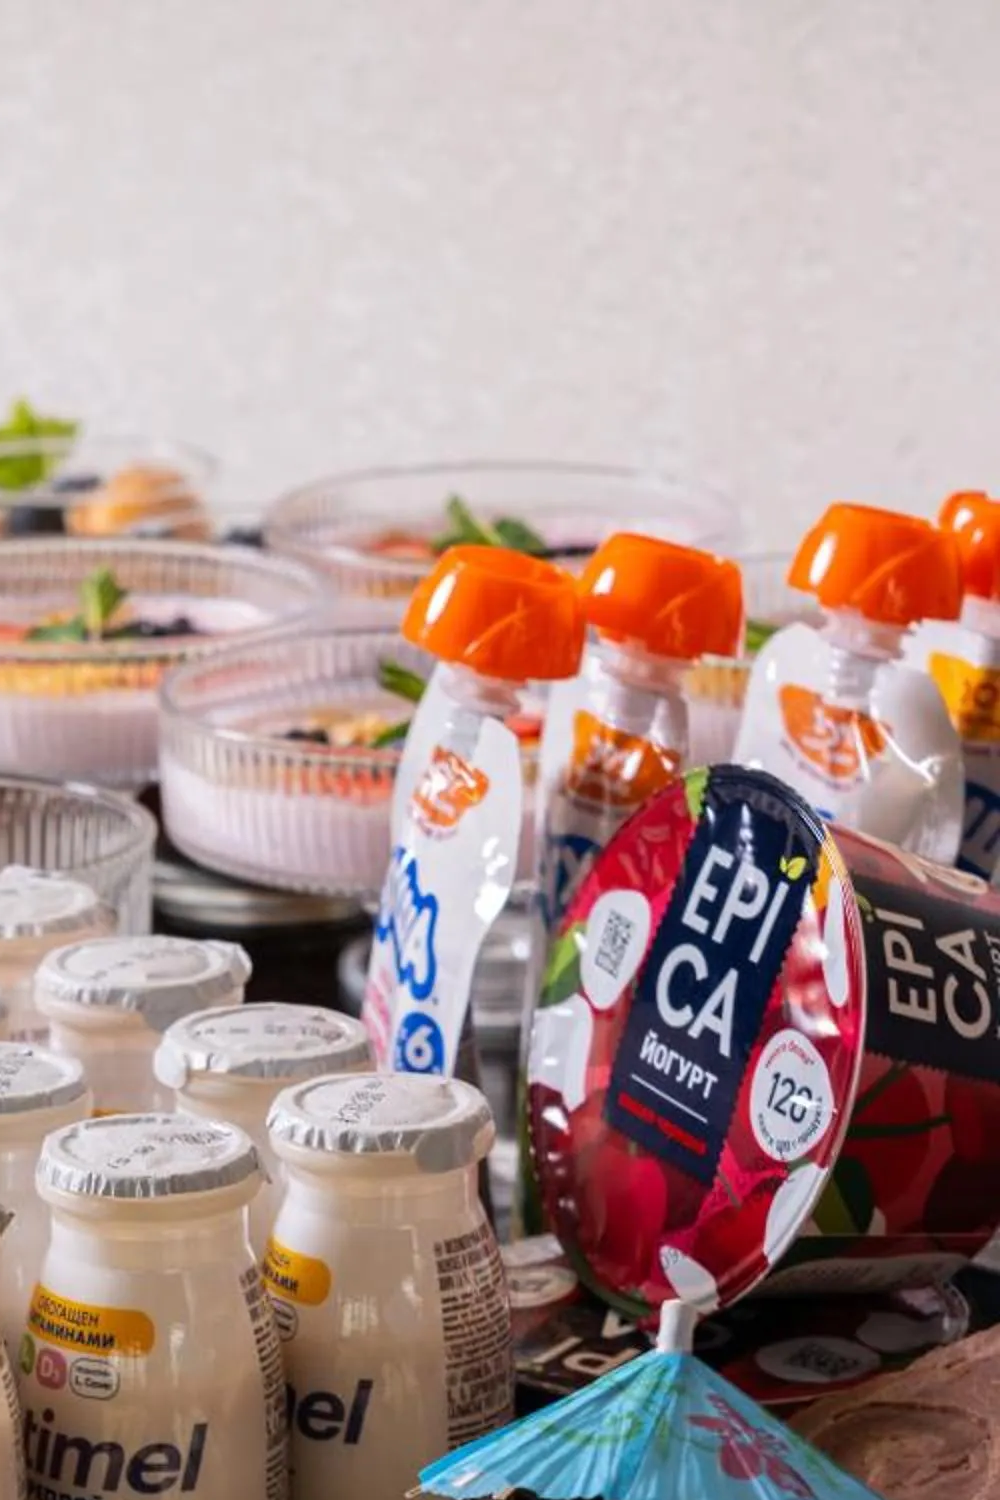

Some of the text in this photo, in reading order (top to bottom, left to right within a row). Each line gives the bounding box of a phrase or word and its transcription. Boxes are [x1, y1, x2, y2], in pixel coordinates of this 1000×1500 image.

[681, 844, 790, 964] EPI
[656, 943, 738, 1058] CA
[875, 907, 937, 1024] EPI
[935, 928, 991, 1039] CA
[639, 1029, 719, 1099] ЙОГУРТ
[23, 1408, 209, 1496] timel
